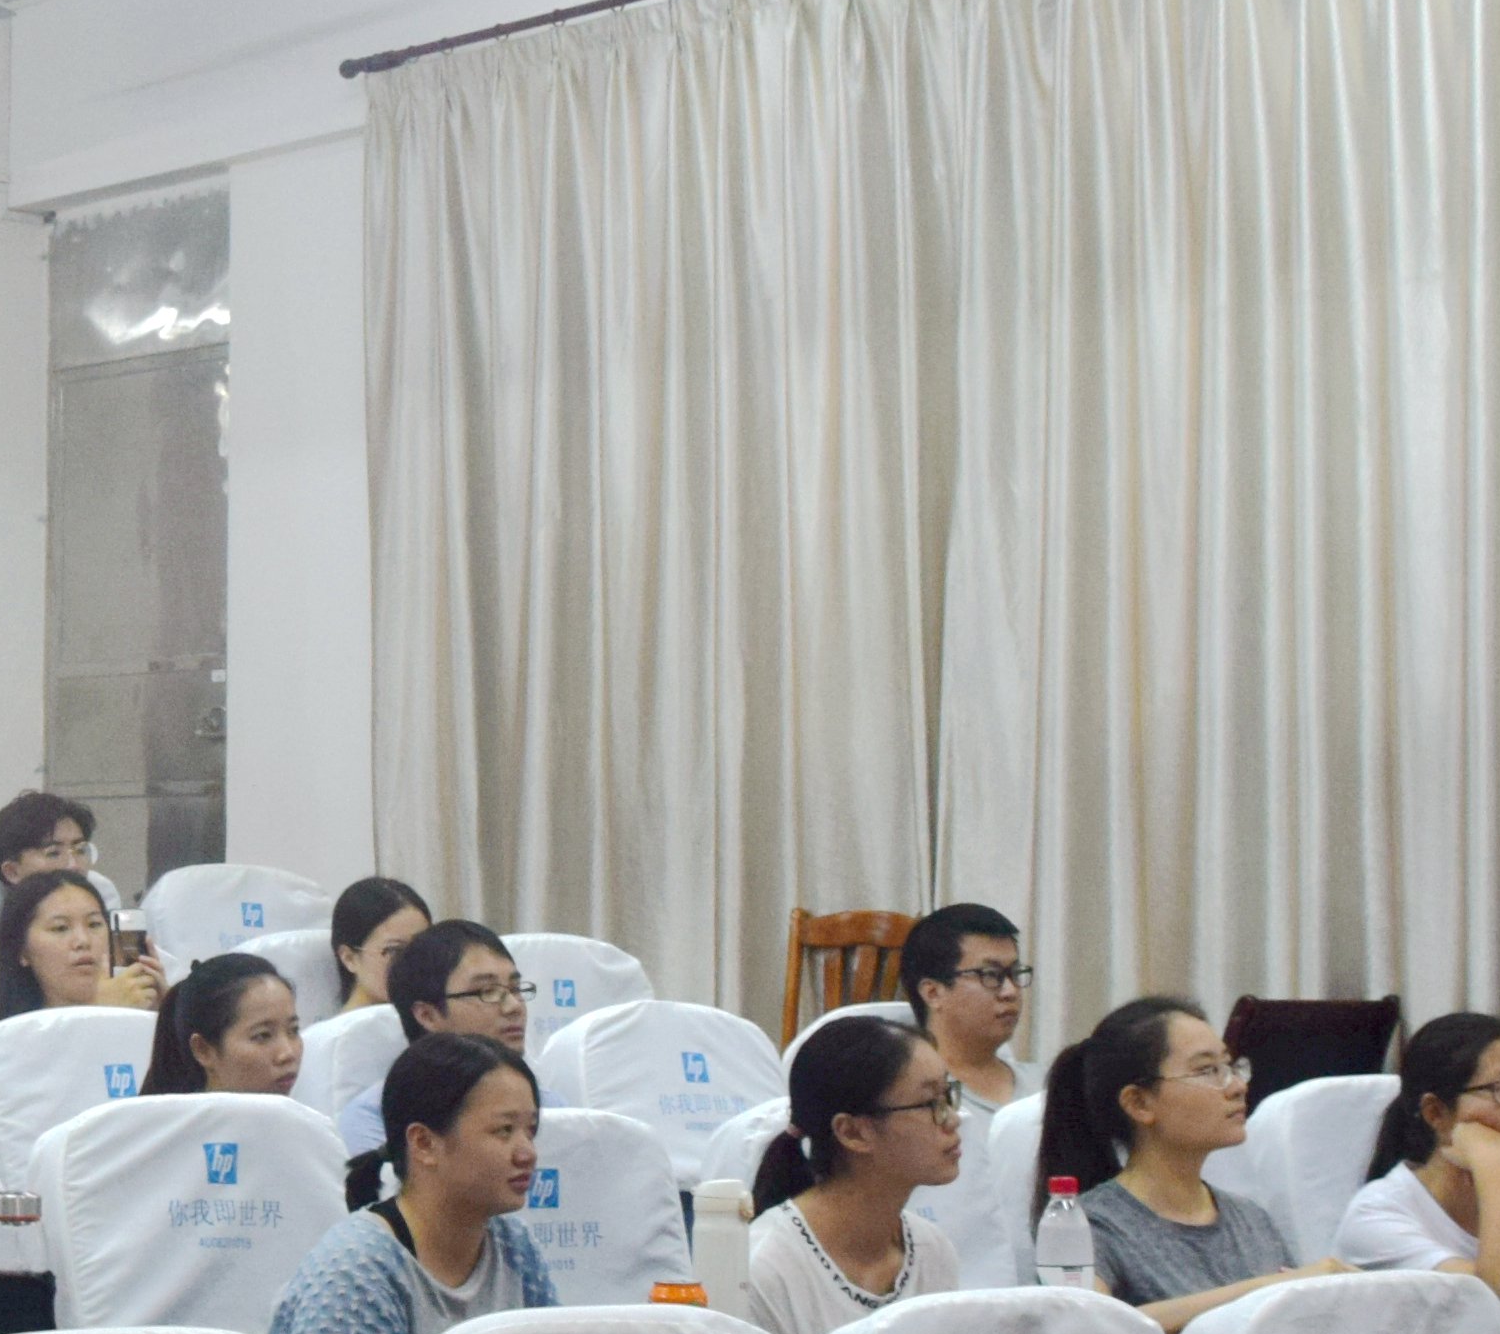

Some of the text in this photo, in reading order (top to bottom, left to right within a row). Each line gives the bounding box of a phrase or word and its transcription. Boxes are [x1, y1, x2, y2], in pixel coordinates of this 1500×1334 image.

[109, 1065, 131, 1097] hp
[211, 1144, 233, 1184] hp
[531, 1169, 554, 1208] hp
[168, 1199, 283, 1228] 你我即世界
[534, 1222, 603, 1248] 即世界
